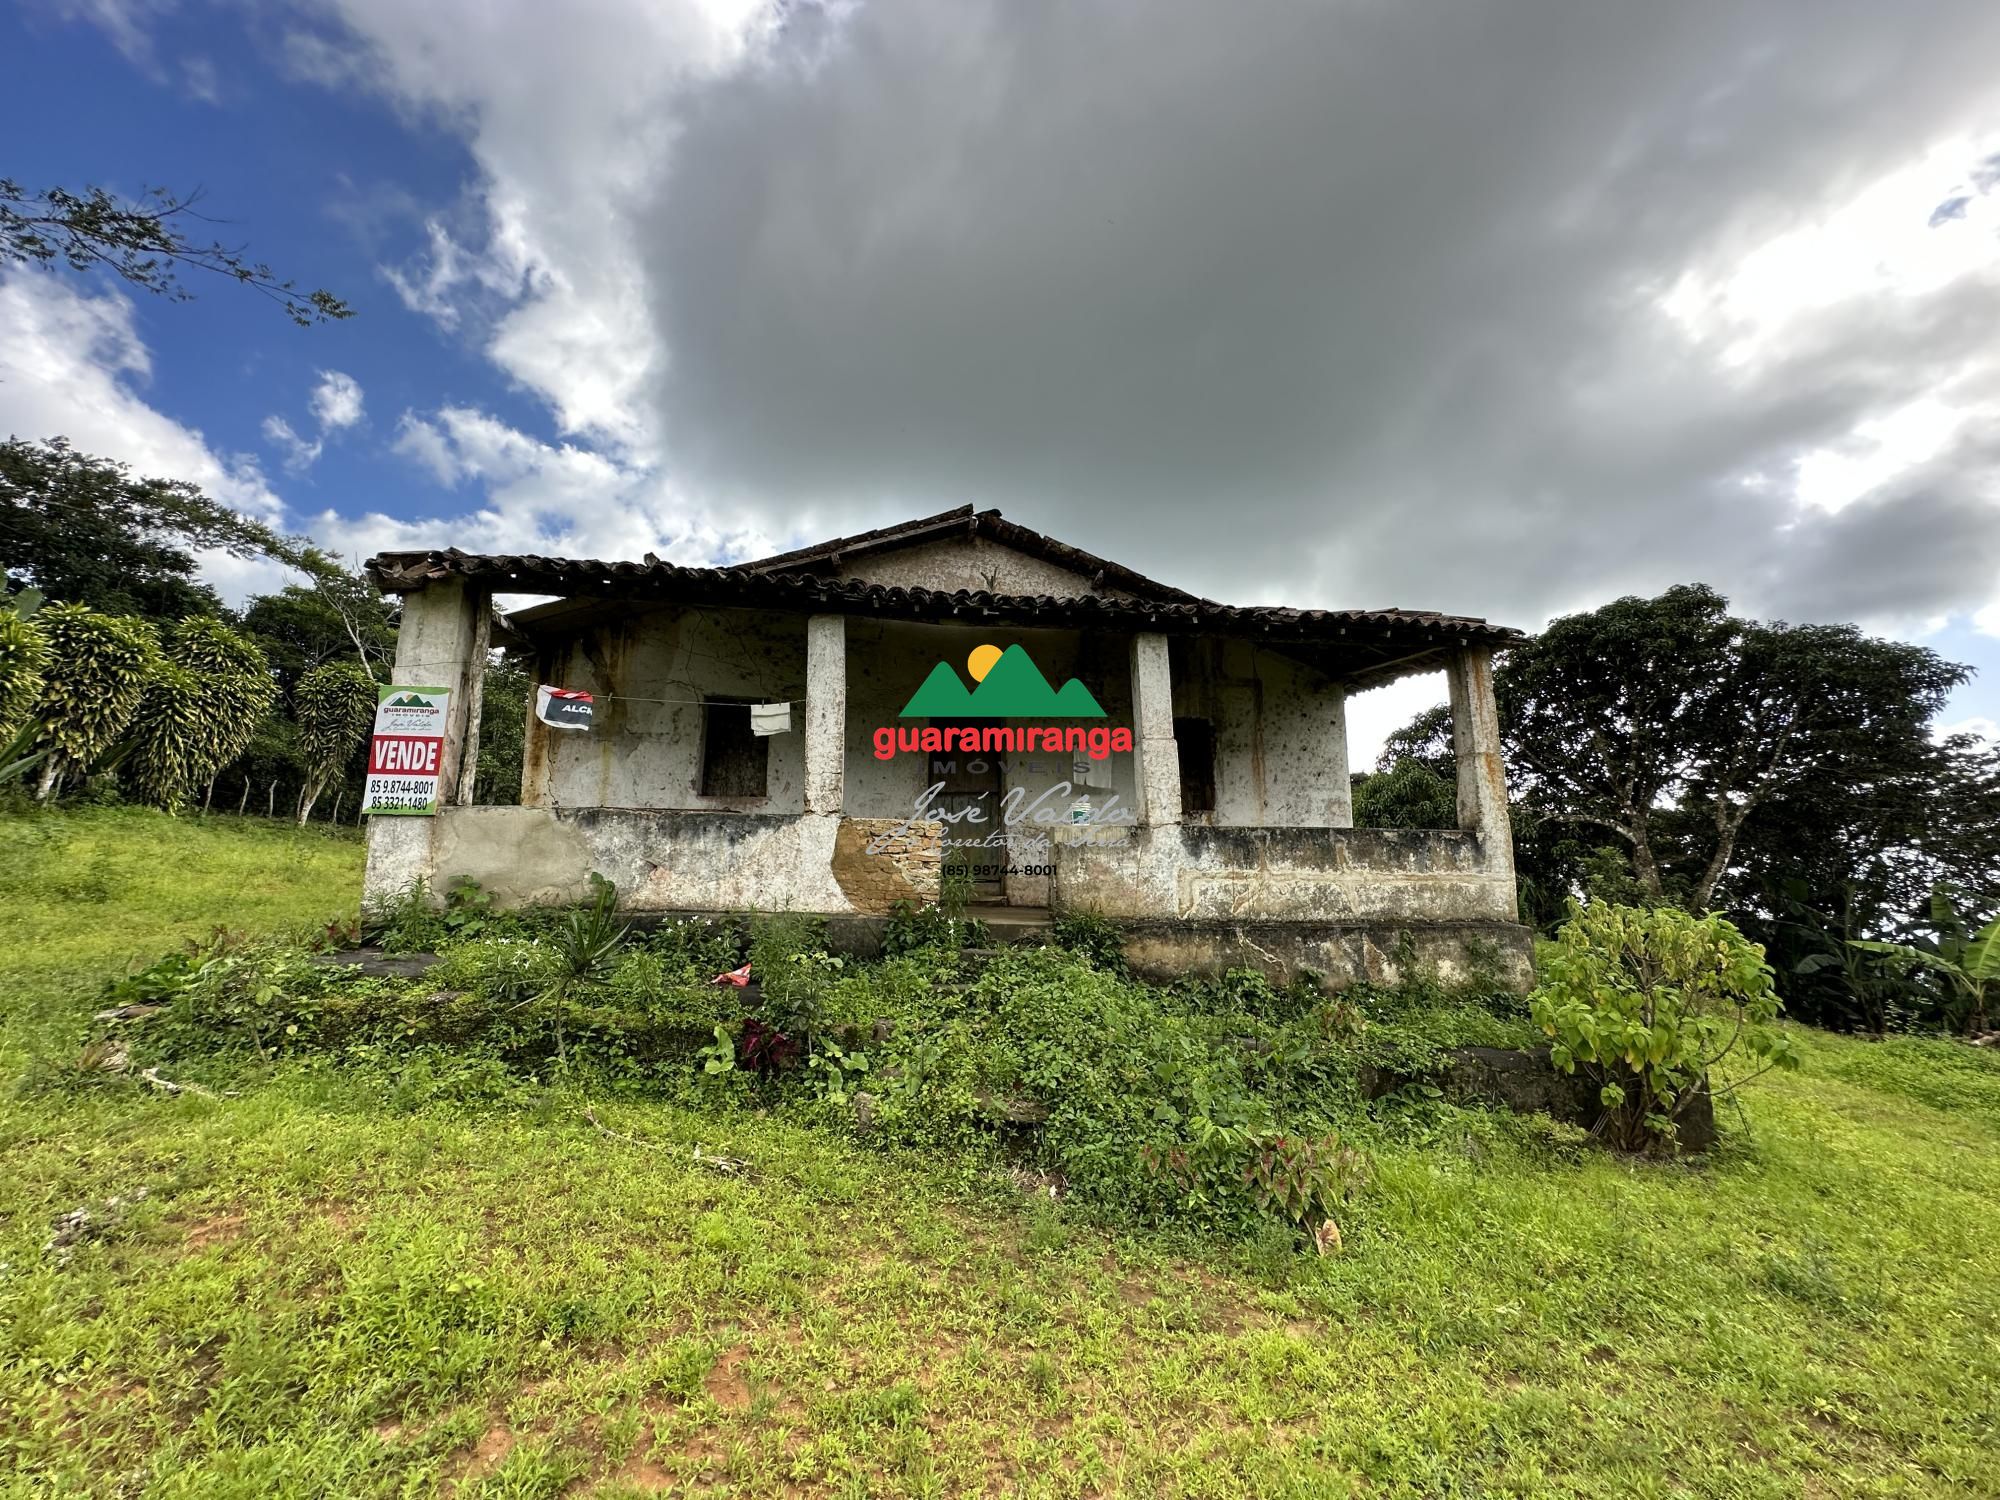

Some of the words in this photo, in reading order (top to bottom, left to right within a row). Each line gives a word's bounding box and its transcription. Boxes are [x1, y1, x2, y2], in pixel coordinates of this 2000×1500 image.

[383, 707, 440, 715] guaramiranga
[375, 740, 438, 771] VENDE
[370, 780, 381, 793] 85
[382, 780, 434, 795] 9.8744-8001
[371, 796, 382, 810] 85
[383, 796, 428, 811] 3321-1480
